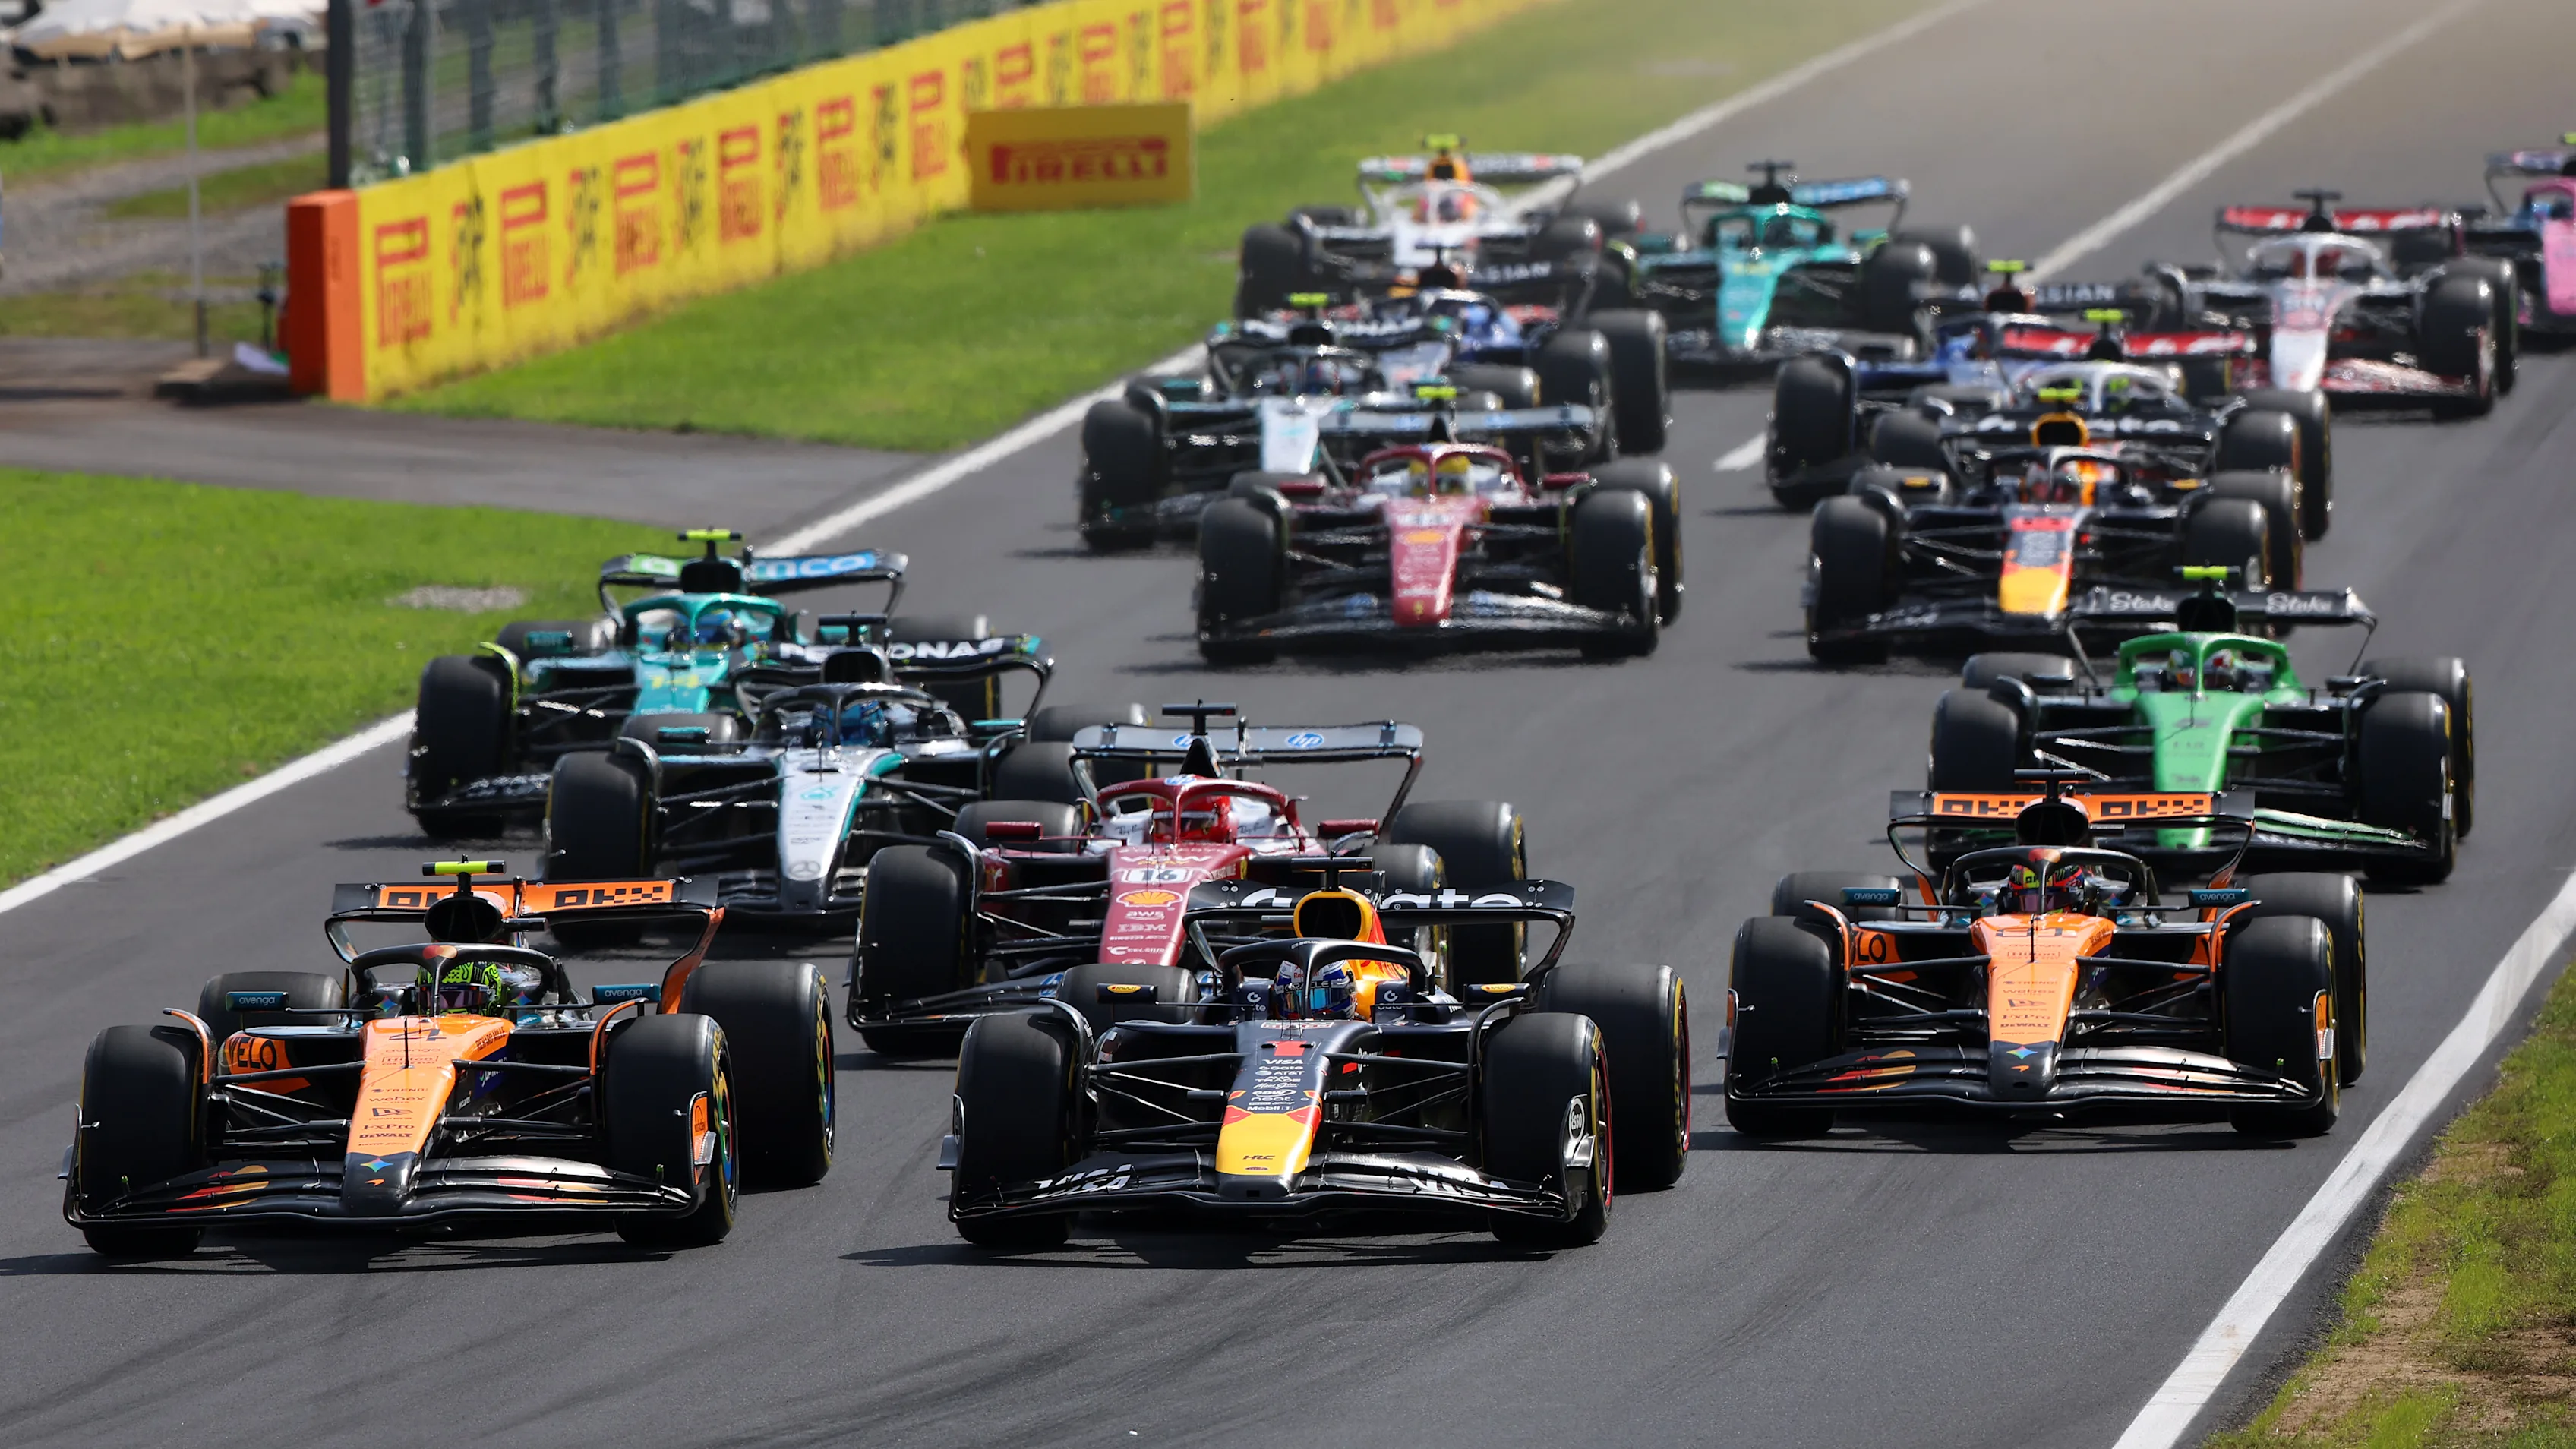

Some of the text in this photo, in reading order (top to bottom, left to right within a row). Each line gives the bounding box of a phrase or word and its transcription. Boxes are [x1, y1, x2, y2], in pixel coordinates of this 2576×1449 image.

[991, 137, 1168, 184] PIRELLI
[641, 552, 867, 578] amco
[779, 637, 1005, 663] PEONAS
[1138, 869, 1178, 881] 16
[1854, 892, 1889, 902] avenga
[2200, 892, 2235, 902] avenga
[1126, 911, 1165, 919] aws
[1117, 924, 1167, 933] IBM
[605, 988, 642, 999] avenga
[239, 996, 276, 1006] avenga
[1570, 1111, 1583, 1129] Esso
